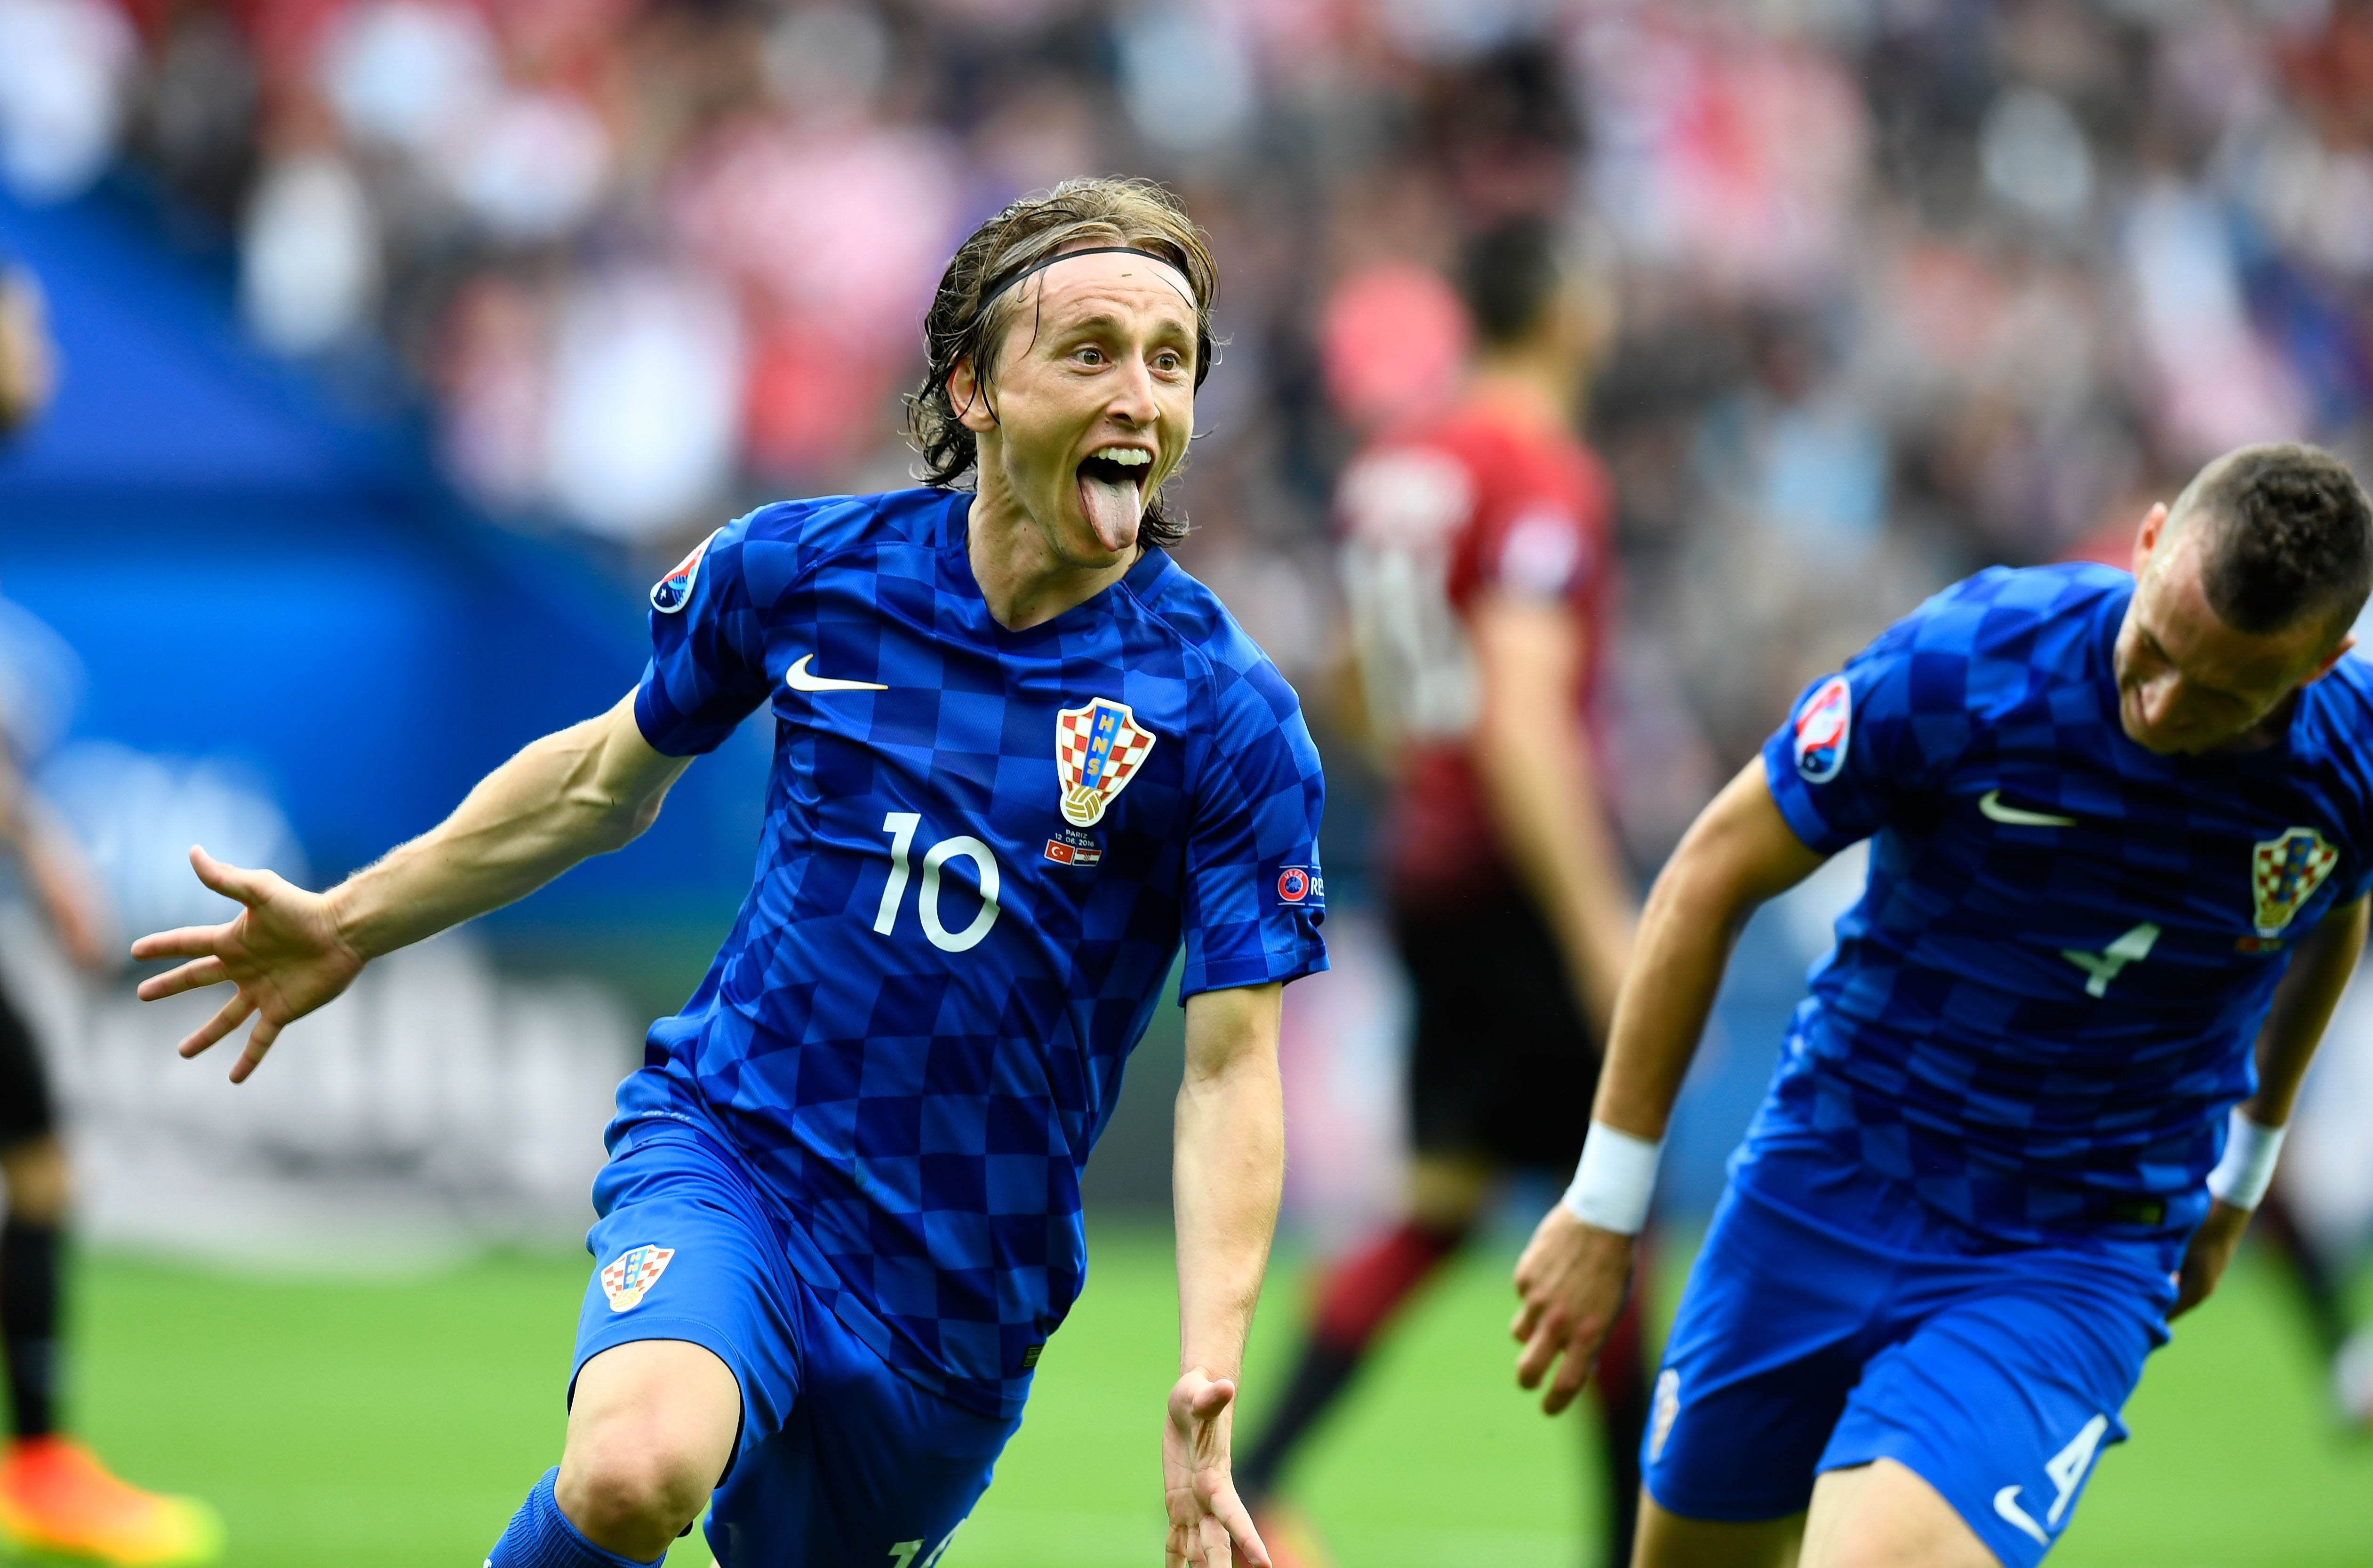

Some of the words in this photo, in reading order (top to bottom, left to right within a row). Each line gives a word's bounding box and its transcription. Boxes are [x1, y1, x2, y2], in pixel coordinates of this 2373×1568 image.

[1087, 714, 1115, 776] HNS
[1066, 829, 1087, 839] PARIZ
[1079, 839, 1094, 847] 2016
[873, 812, 1000, 953] 10
[1284, 871, 1303, 879] UEFA
[1310, 877, 1325, 897] RE
[2059, 921, 2162, 999] 4
[2045, 1412, 2109, 1526] 4
